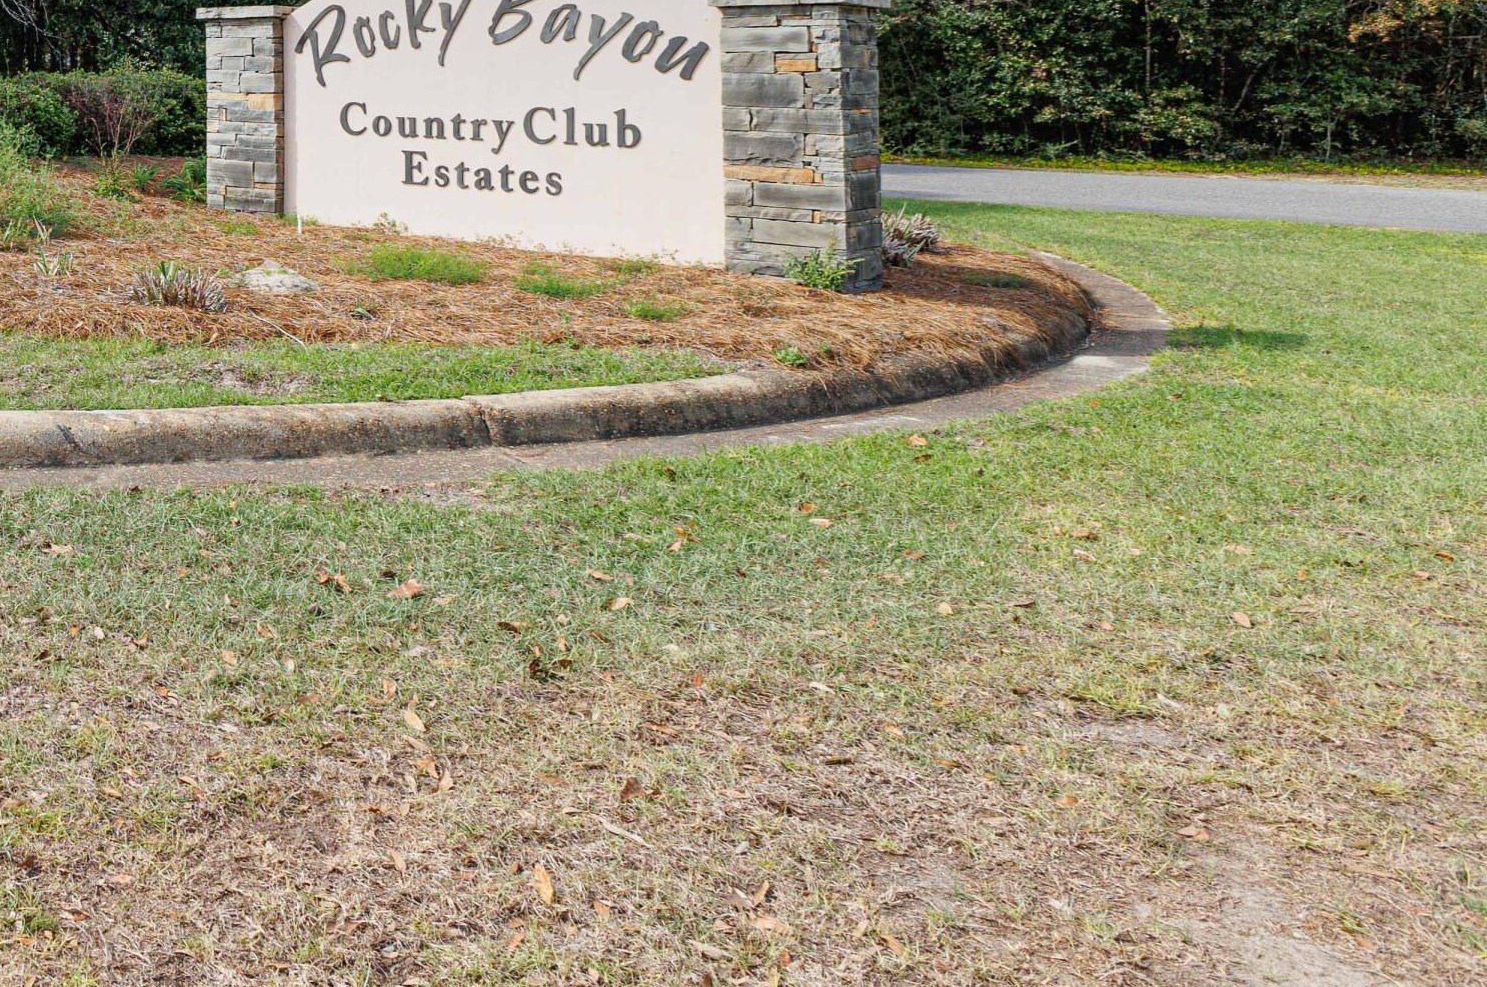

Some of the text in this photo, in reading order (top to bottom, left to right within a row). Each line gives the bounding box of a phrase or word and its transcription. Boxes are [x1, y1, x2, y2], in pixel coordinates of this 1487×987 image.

[339, 101, 642, 155] Country Club
[401, 150, 563, 196] Estates
